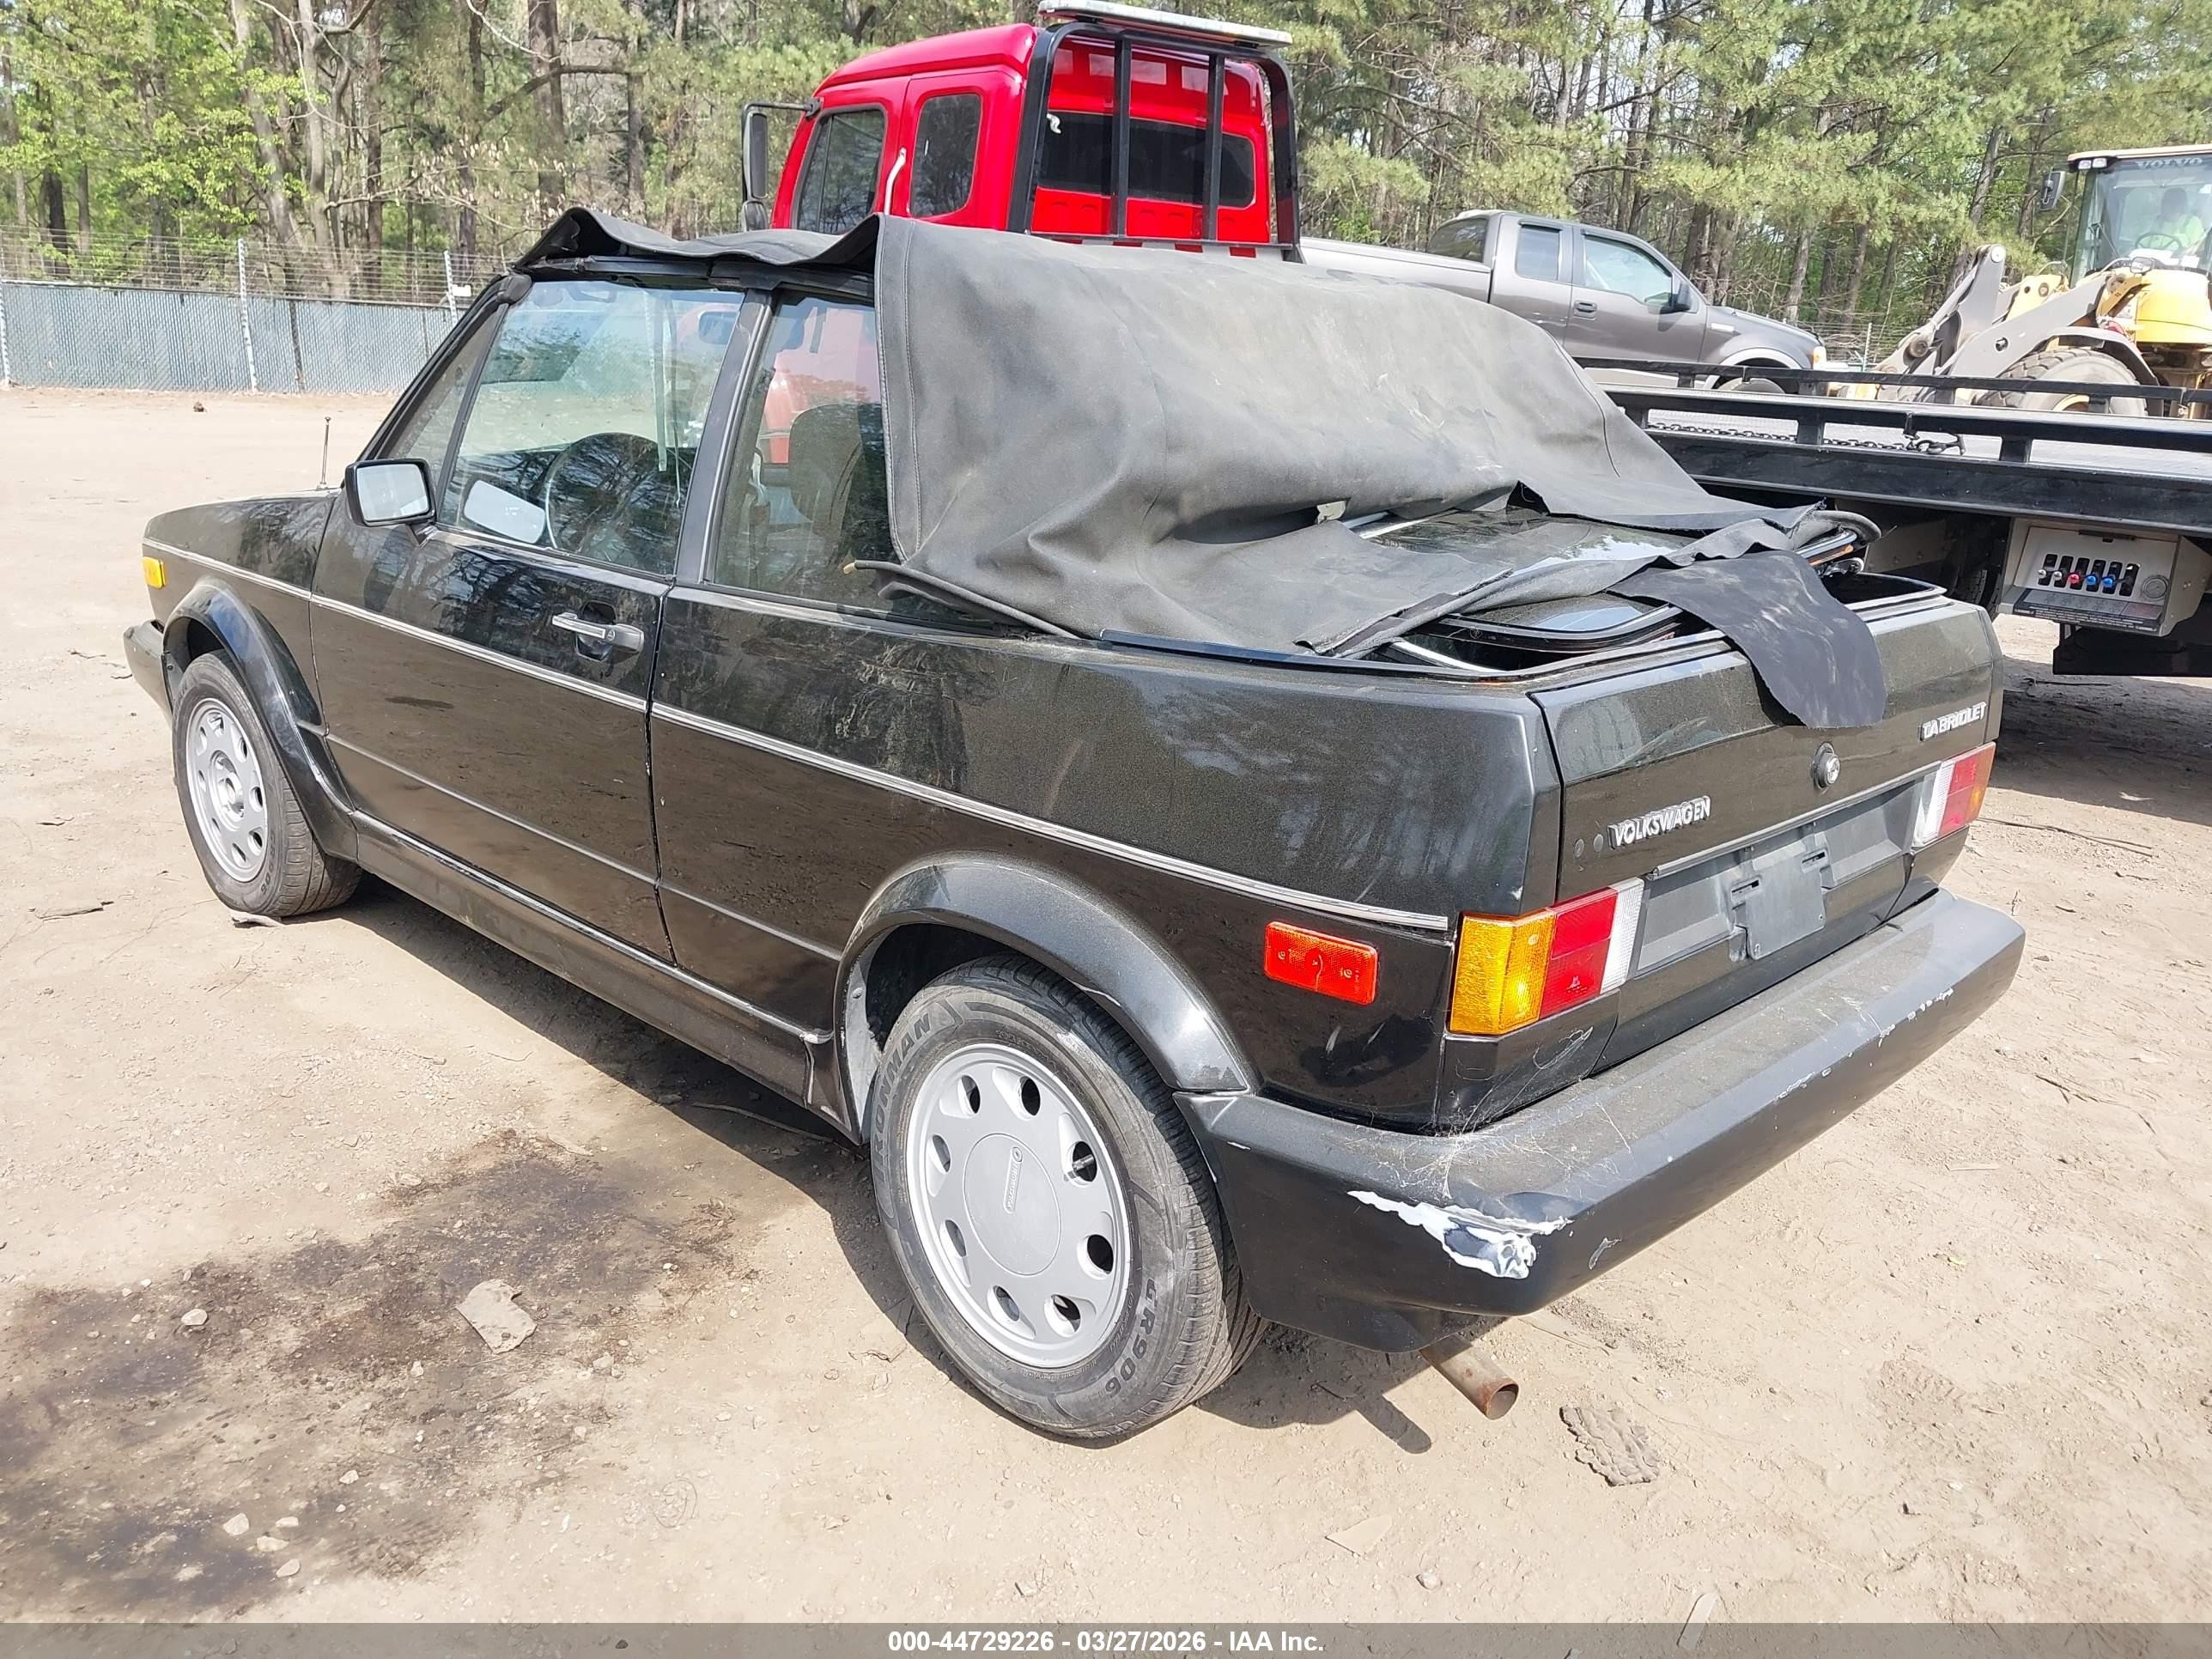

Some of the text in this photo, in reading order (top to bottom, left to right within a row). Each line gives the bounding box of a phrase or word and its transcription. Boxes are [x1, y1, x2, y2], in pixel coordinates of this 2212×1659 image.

[1607, 796, 1712, 849] VOLKSWAGEN
[873, 1013, 932, 1183] IRONMAN
[1104, 1278, 1158, 1400] GR906
